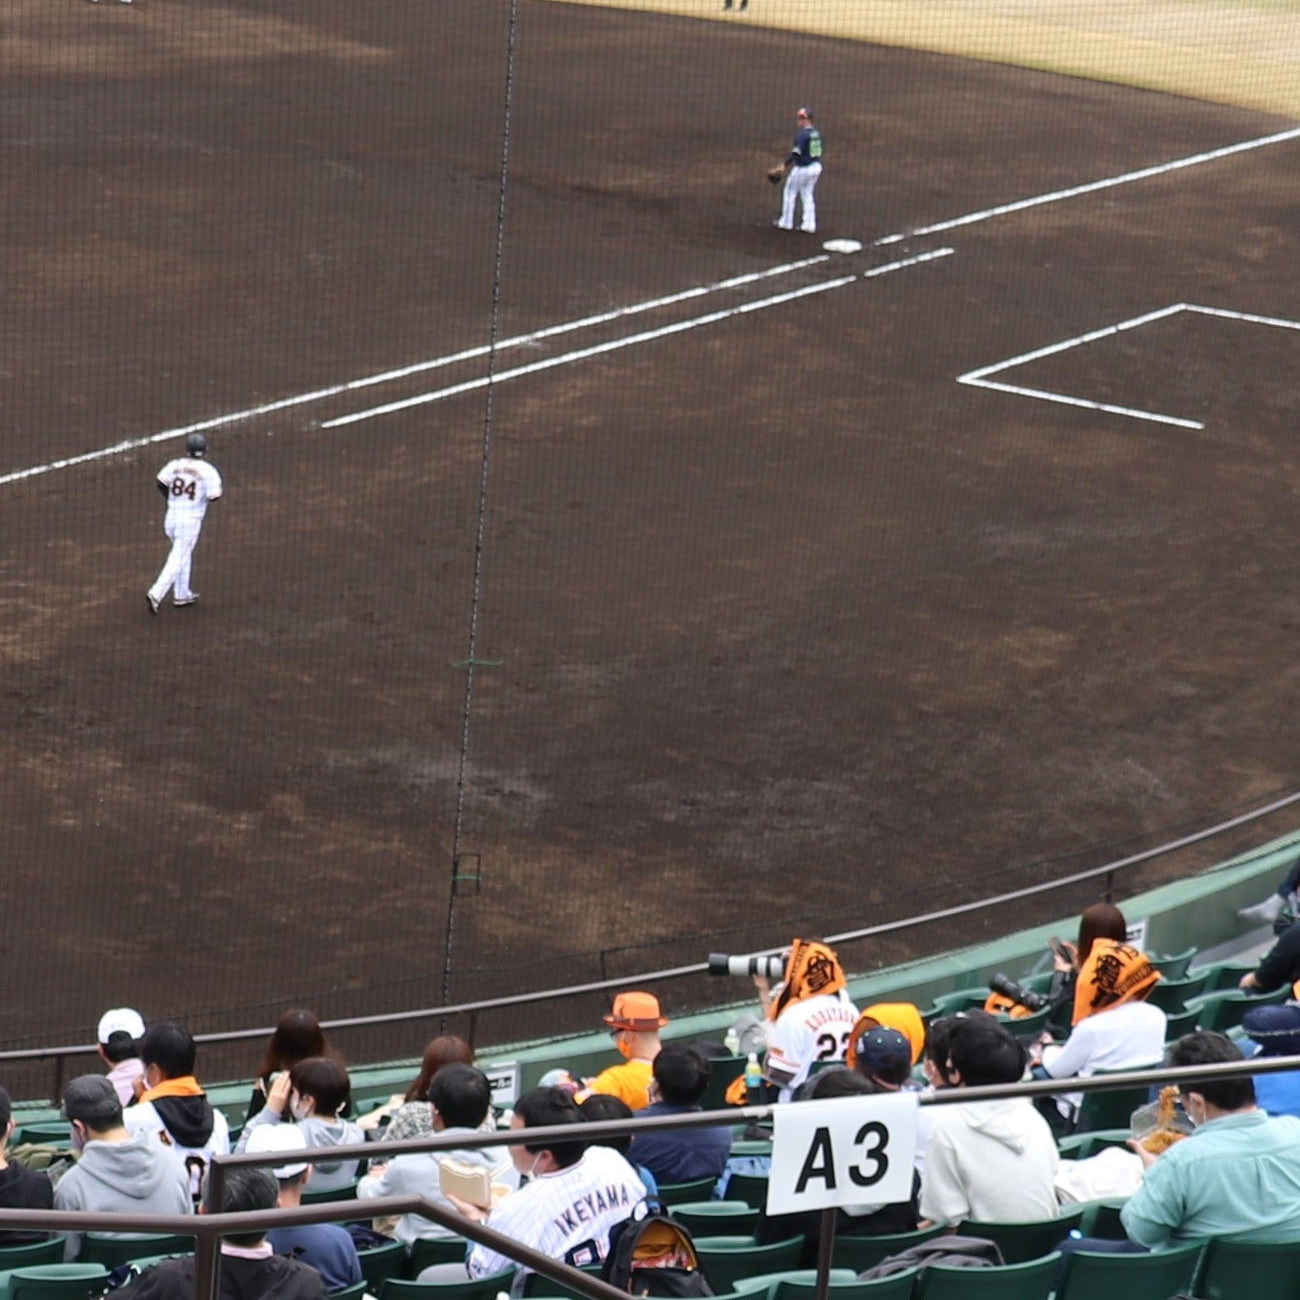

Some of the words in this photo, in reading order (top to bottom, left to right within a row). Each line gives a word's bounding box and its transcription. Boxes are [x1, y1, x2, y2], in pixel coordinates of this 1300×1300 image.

[172, 476, 196, 502] 84
[794, 1120, 890, 1195] A3
[554, 1183, 629, 1237] IKEYAMA
